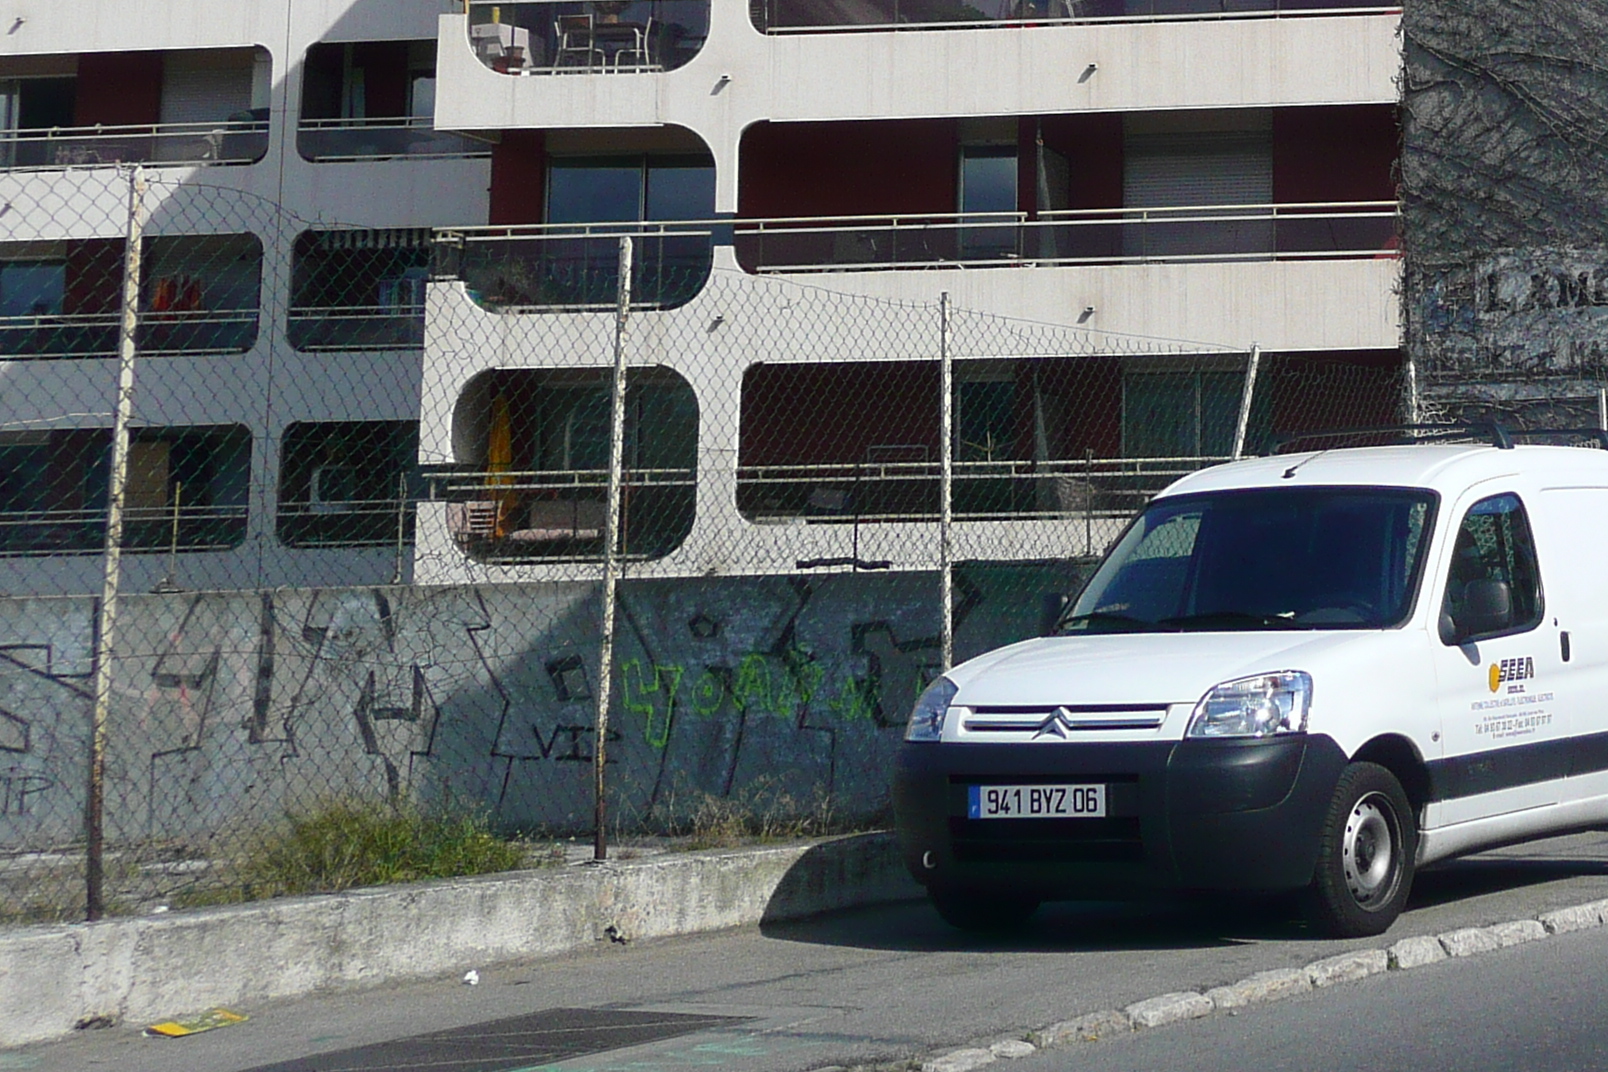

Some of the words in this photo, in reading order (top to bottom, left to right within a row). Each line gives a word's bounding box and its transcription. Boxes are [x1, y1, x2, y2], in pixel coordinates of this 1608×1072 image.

[1498, 656, 1534, 683] SEEA
[986, 789, 1021, 814] 941
[1030, 788, 1066, 814] BYZ
[1073, 787, 1097, 813] 06
